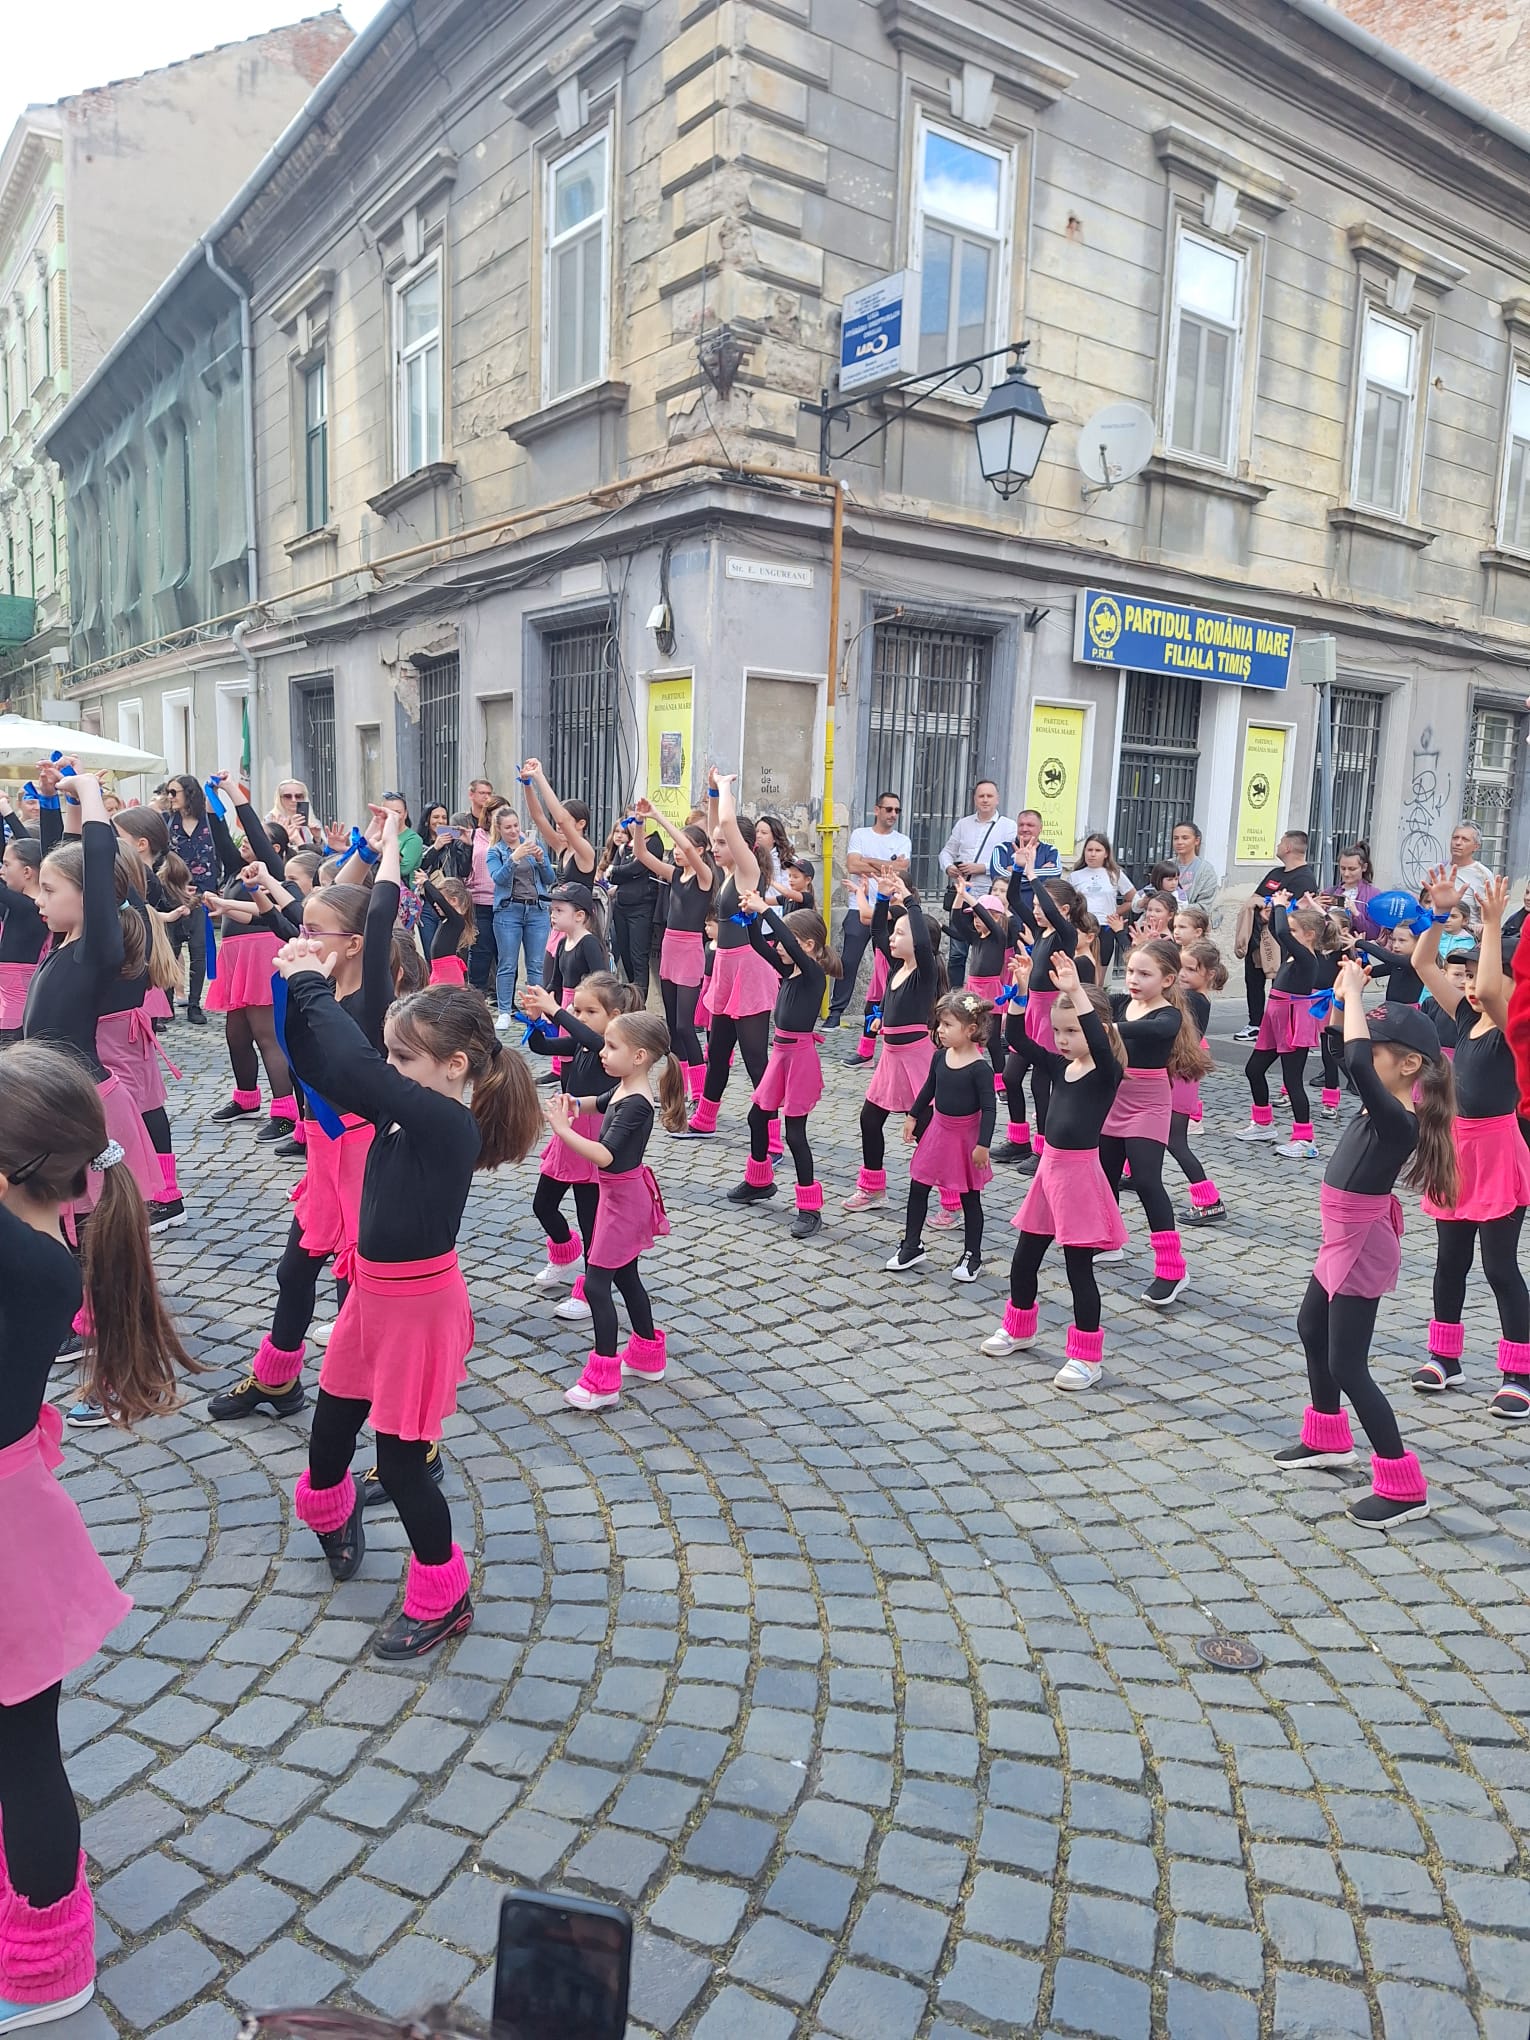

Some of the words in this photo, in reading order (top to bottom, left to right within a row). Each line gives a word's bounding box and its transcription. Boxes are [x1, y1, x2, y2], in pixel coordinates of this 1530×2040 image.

[759, 567, 808, 581] UNGUREANU
[1124, 604, 1192, 642] PARTIDUL
[1195, 617, 1253, 652] ROMÂNIA
[1255, 628, 1290, 658] MARE
[1091, 647, 1115, 661] P.R.M.
[1164, 643, 1214, 671] FILIALA
[1217, 651, 1252, 682] TIMIȘ
[661, 691, 685, 701] PARTIDUL
[1043, 717, 1069, 726] PARTIDUL
[1035, 726, 1060, 735] ROMÂNIA
[1061, 728, 1076, 736] MARE
[761, 775, 771, 784] de
[761, 784, 780, 793] oftat
